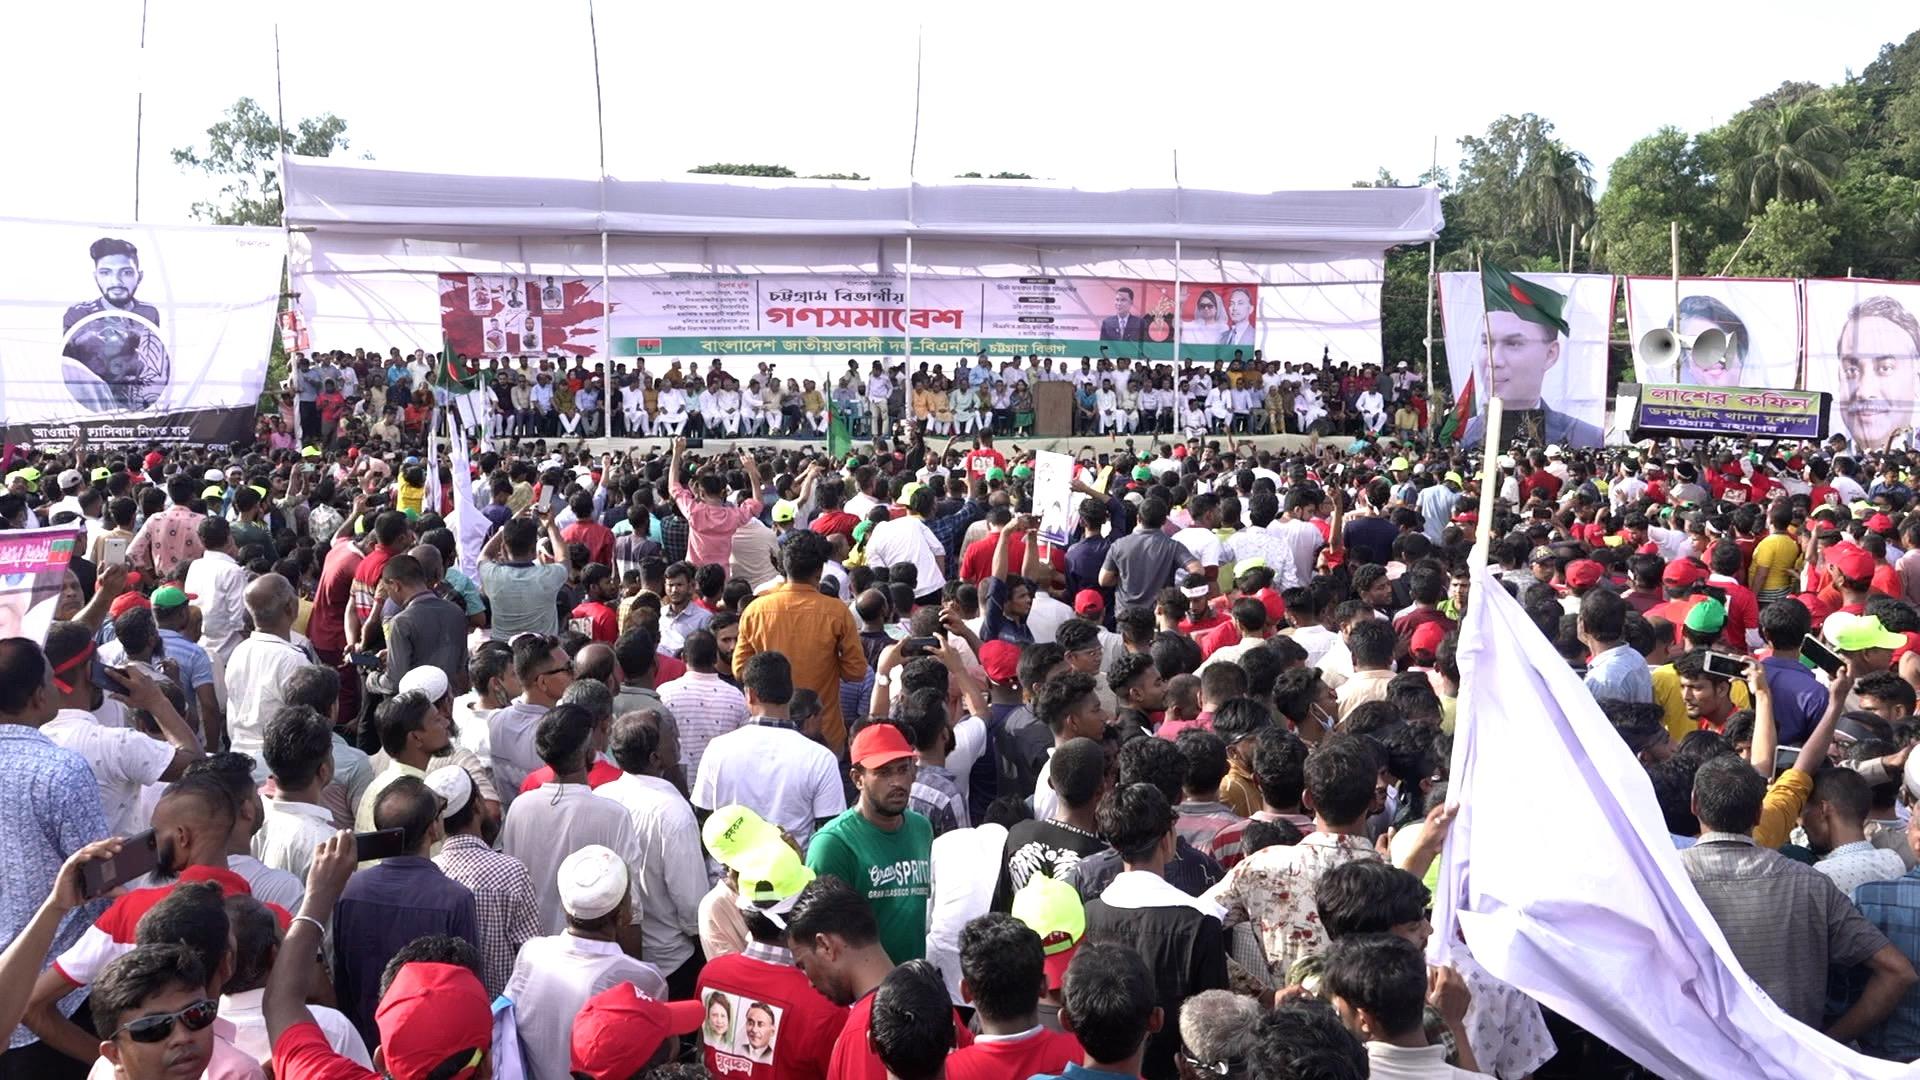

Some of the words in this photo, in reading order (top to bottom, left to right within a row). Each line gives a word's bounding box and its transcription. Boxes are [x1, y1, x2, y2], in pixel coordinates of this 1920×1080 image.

[768, 288, 827, 304] চট্টগ্রাম
[835, 288, 904, 304] বিভাগীয়
[765, 307, 964, 333] গণসমাবেশ
[701, 338, 777, 354] বাংলাদেশ
[782, 335, 884, 353] জাতীয়তাবাদী
[989, 341, 1028, 354] চট্টগ্রাম
[1032, 341, 1067, 355] বিভাগ
[1650, 388, 1731, 406] লাশের
[1737, 391, 1811, 410] কফিন
[1667, 418, 1715, 429] চট্টগ্রাম
[1721, 423, 1778, 433] মহানগর
[1725, 411, 1759, 422] থানা
[1764, 415, 1812, 425] যুবদল
[31, 424, 81, 438] আওয়ামী
[171, 426, 191, 436] যাক
[1056, 821, 1081, 834] FUTURE
[715, 1052, 753, 1077] যুবদল
